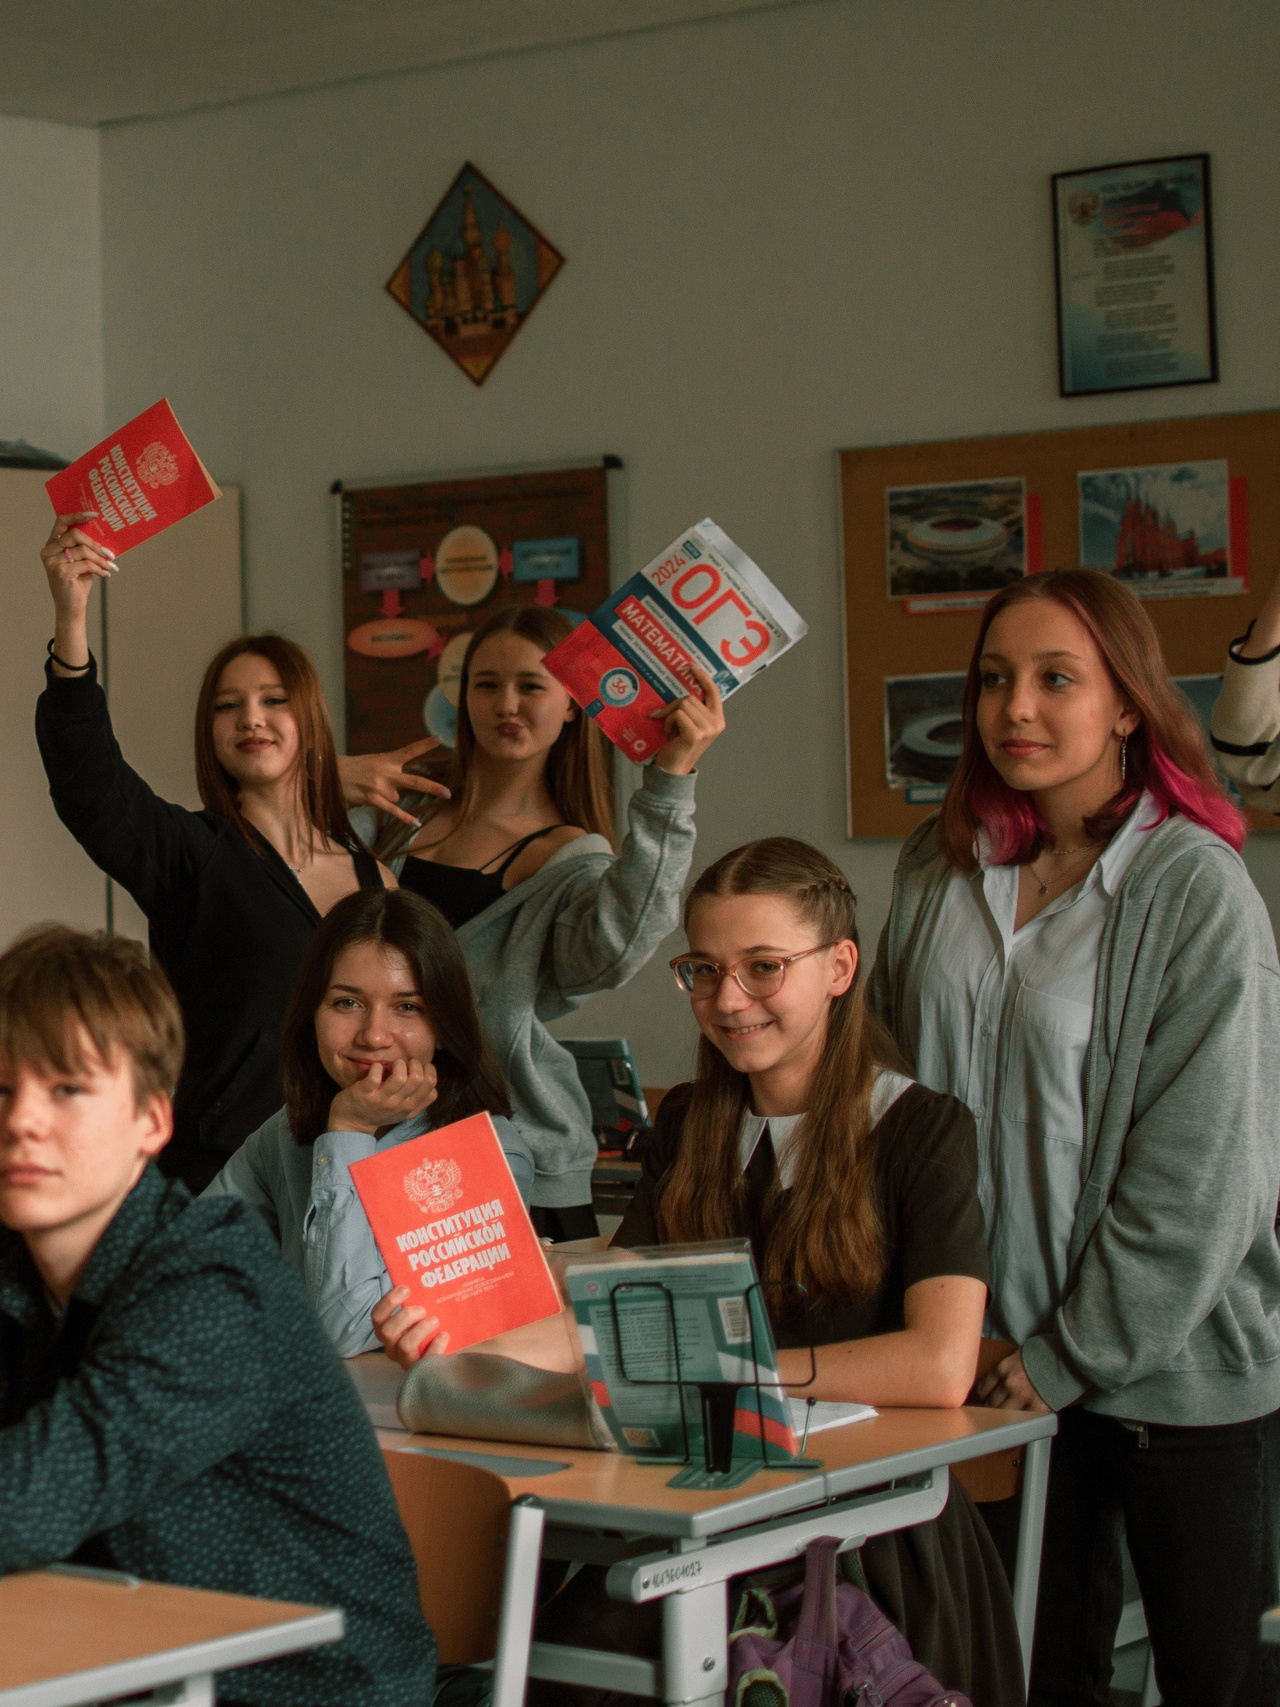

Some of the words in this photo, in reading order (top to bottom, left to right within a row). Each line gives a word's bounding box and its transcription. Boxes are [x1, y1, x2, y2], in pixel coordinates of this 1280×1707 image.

[88, 468, 126, 532] ФЕДЕРАЦИИ
[98, 455, 143, 526] РОССИЙСКОЙ
[109, 443, 158, 521] КОНСТИТУЦИЯ
[651, 554, 686, 586] 2024
[671, 563, 771, 666] ОГЭ
[611, 677, 629, 695] 36
[396, 1198, 505, 1252] КОНСТИТУЦИЯ
[408, 1219, 507, 1271] РОССИЙСКОЙ
[421, 1242, 511, 1288] ФЕДЕРАЦИИ
